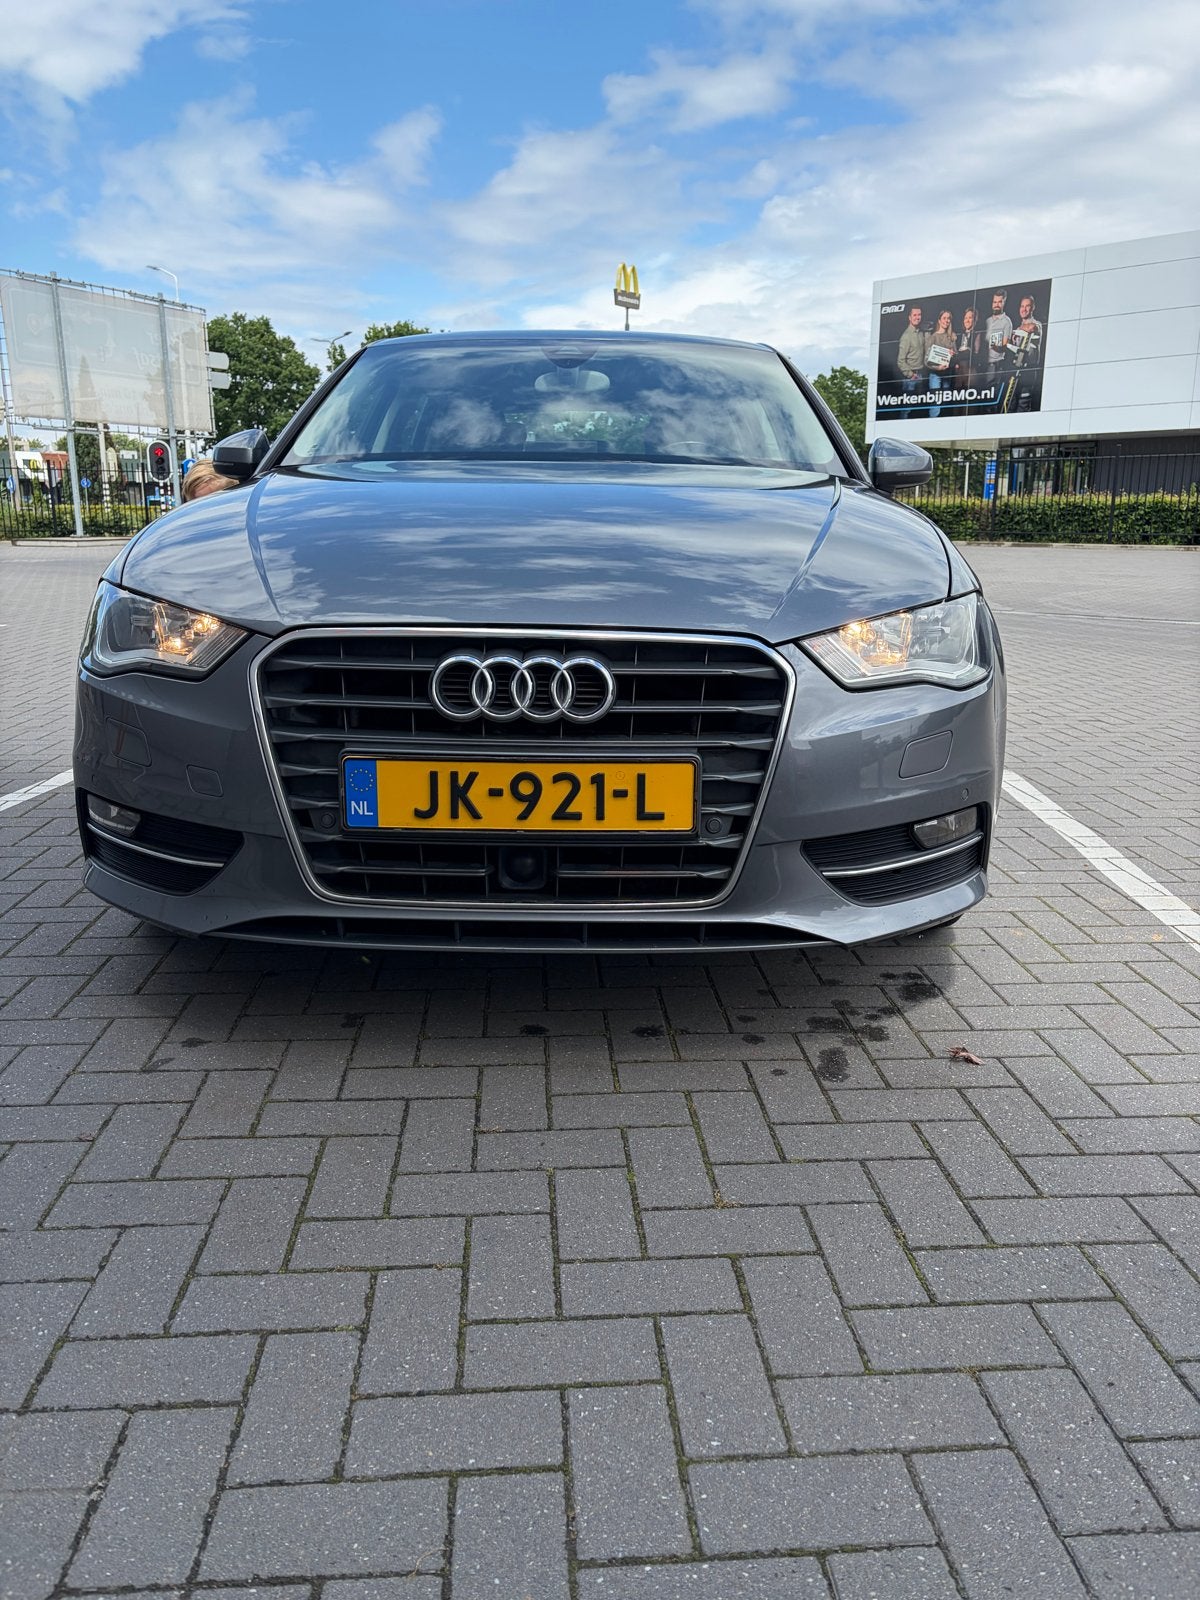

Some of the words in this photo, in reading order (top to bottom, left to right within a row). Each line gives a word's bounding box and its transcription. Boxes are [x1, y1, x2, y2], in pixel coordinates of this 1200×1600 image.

[877, 387, 994, 405] WerkenbijBMO.nl
[413, 770, 666, 821] JK-921-L
[351, 800, 374, 816] NL
